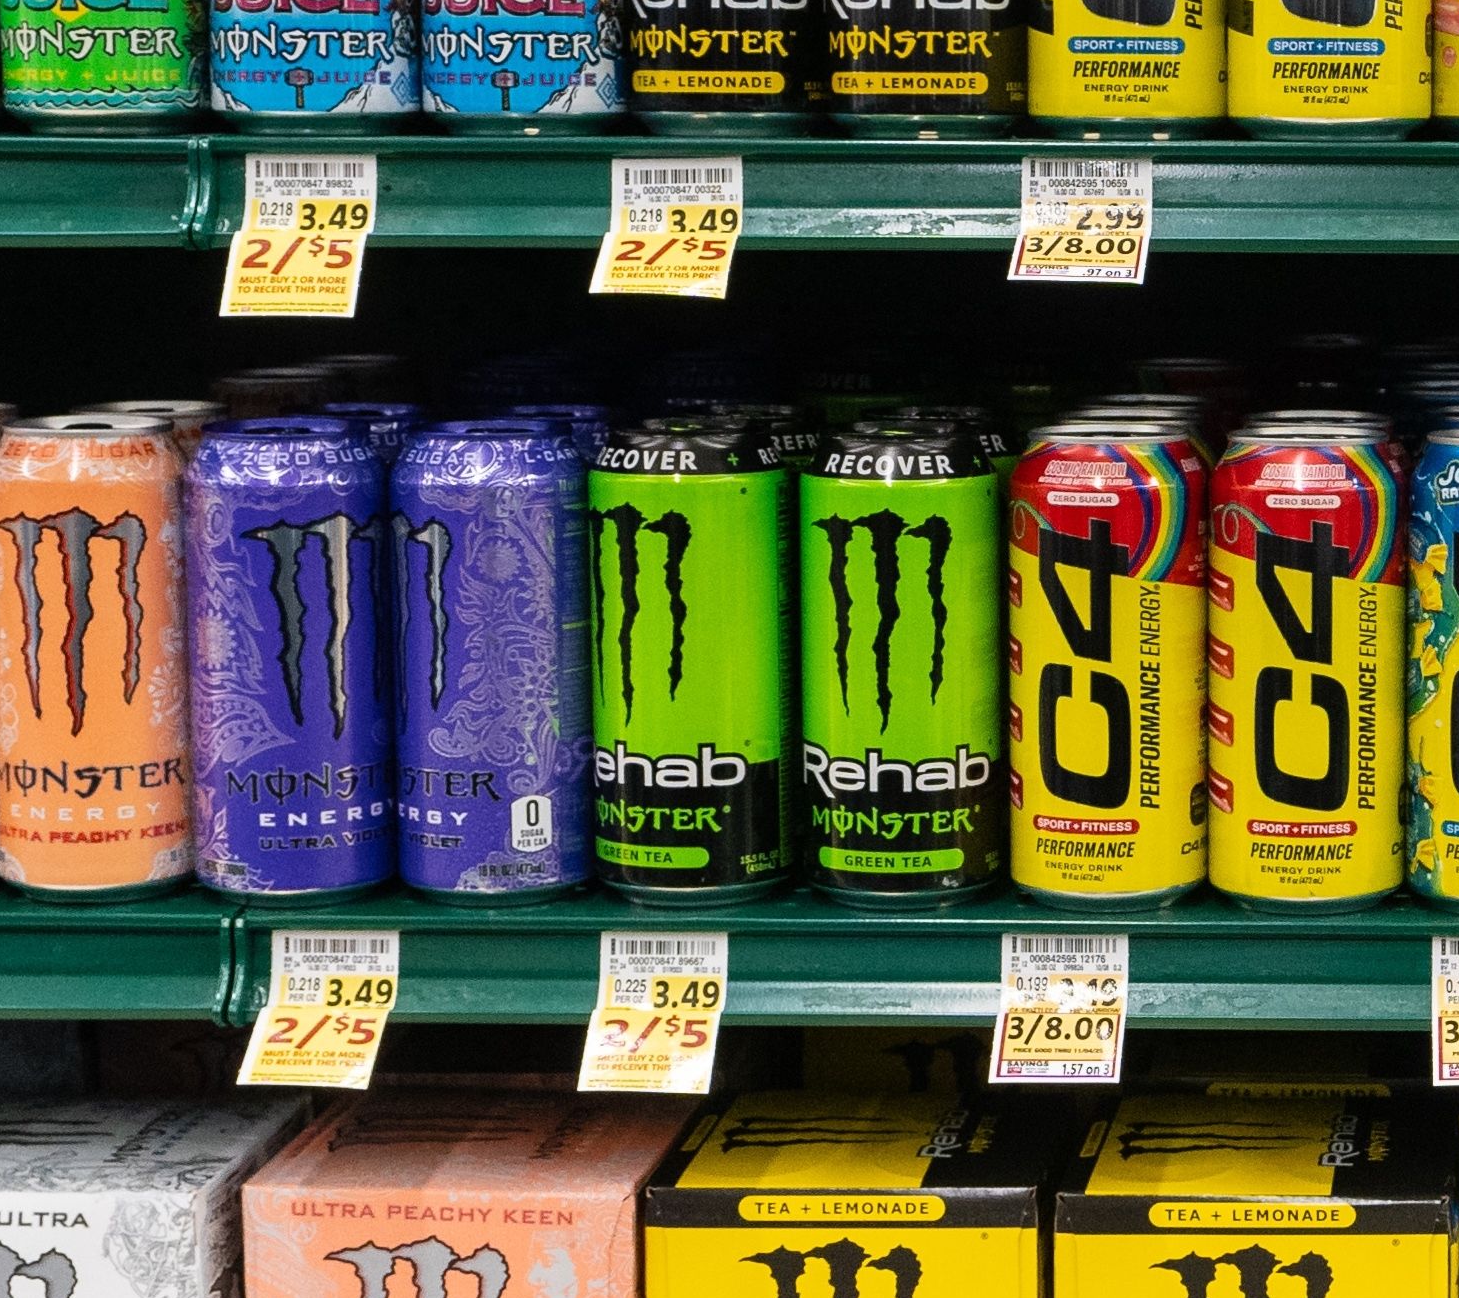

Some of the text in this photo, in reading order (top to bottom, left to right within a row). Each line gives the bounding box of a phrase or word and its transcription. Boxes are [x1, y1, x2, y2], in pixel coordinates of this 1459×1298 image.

[1074, 39, 1117, 52] SPORT
[1128, 39, 1179, 52] FITNESS
[1073, 61, 1180, 80] PERFORMANCE
[1084, 83, 1168, 93] ENERGY DRINK
[241, 275, 346, 285] MUST BUY 2 OR MORE
[238, 285, 249, 294] TO
[296, 285, 314, 294] THIS
[316, 285, 346, 294] PRICE
[802, 745, 990, 796] Rehab
[812, 805, 972, 838] MONSTER
[844, 853, 932, 869] GREEN TEA
[292, 1202, 573, 1225] ULTRA PEACHY KEEN
[1165, 1208, 1202, 1223] TEA
[1232, 1208, 1342, 1223] LEMONADE
